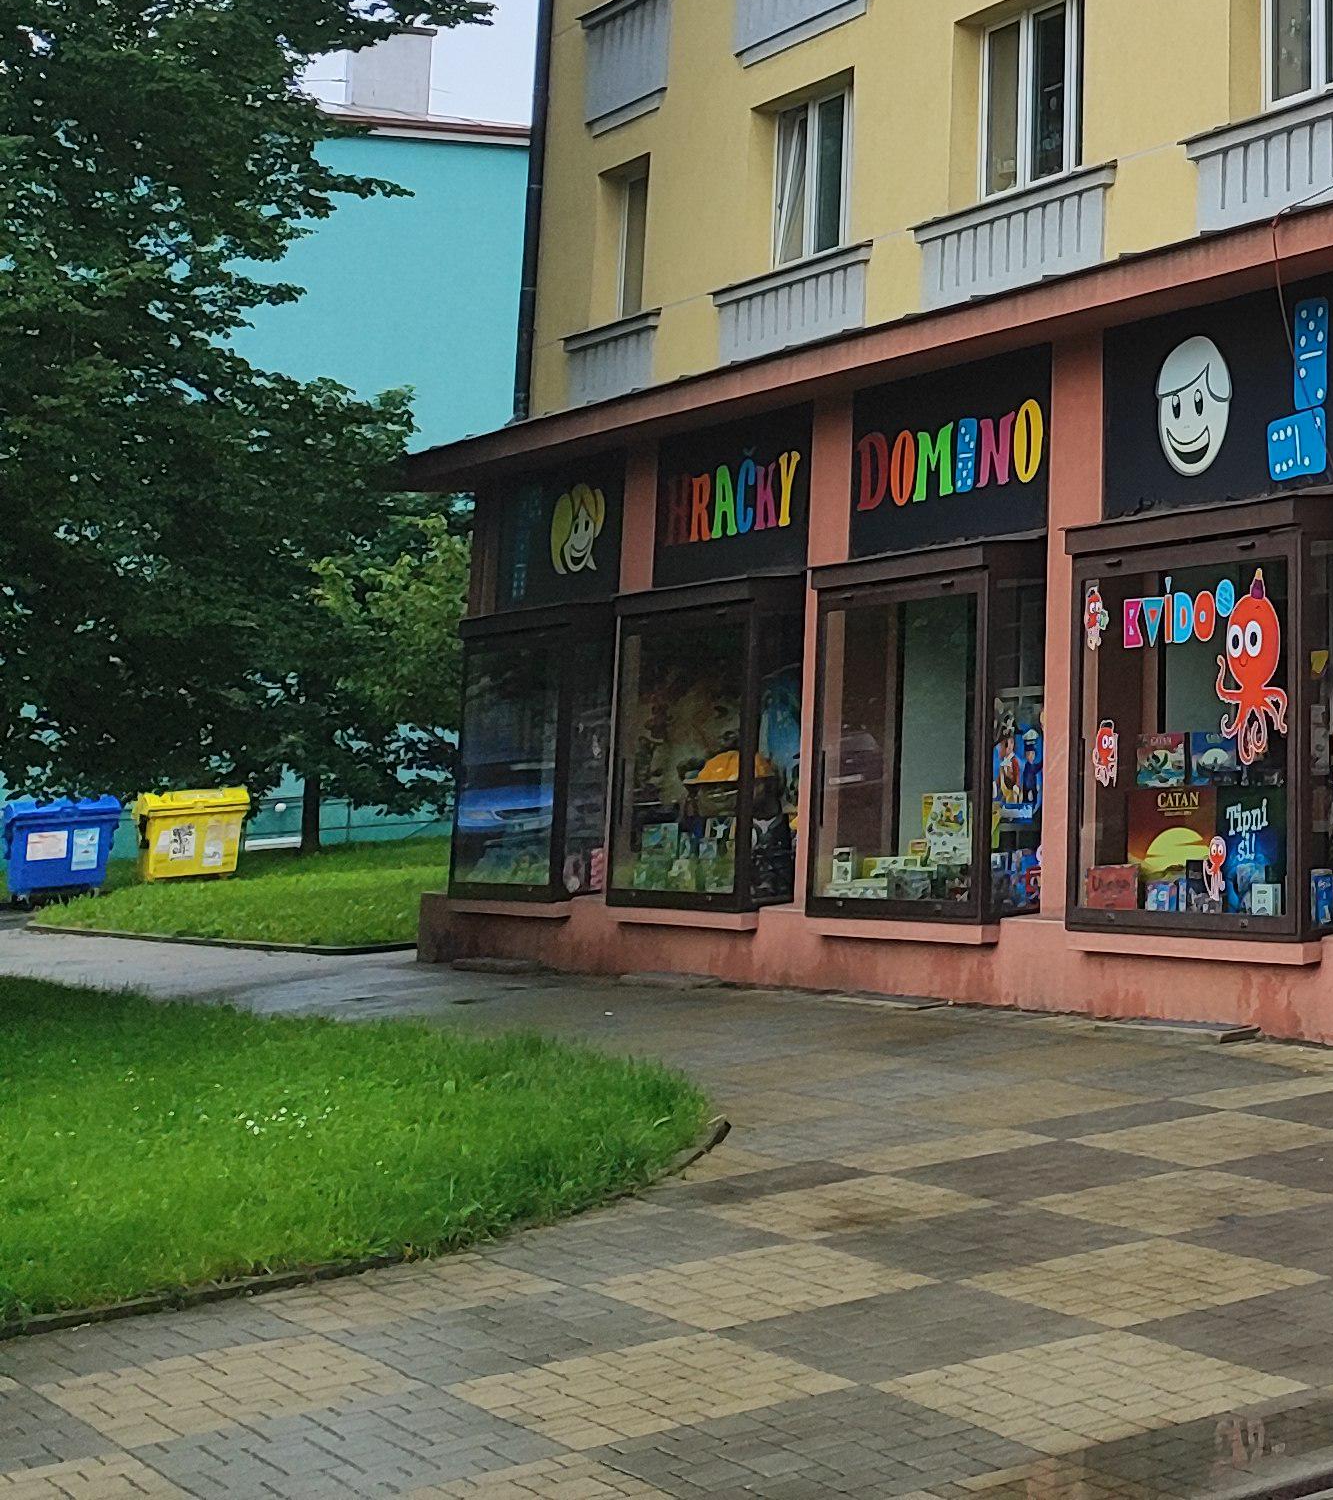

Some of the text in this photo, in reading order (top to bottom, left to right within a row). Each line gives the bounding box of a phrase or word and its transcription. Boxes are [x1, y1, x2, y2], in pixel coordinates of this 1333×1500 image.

[856, 398, 1044, 512] DOMINO
[1157, 791, 1200, 809] CATAN
[1226, 798, 1269, 837] Tipni
